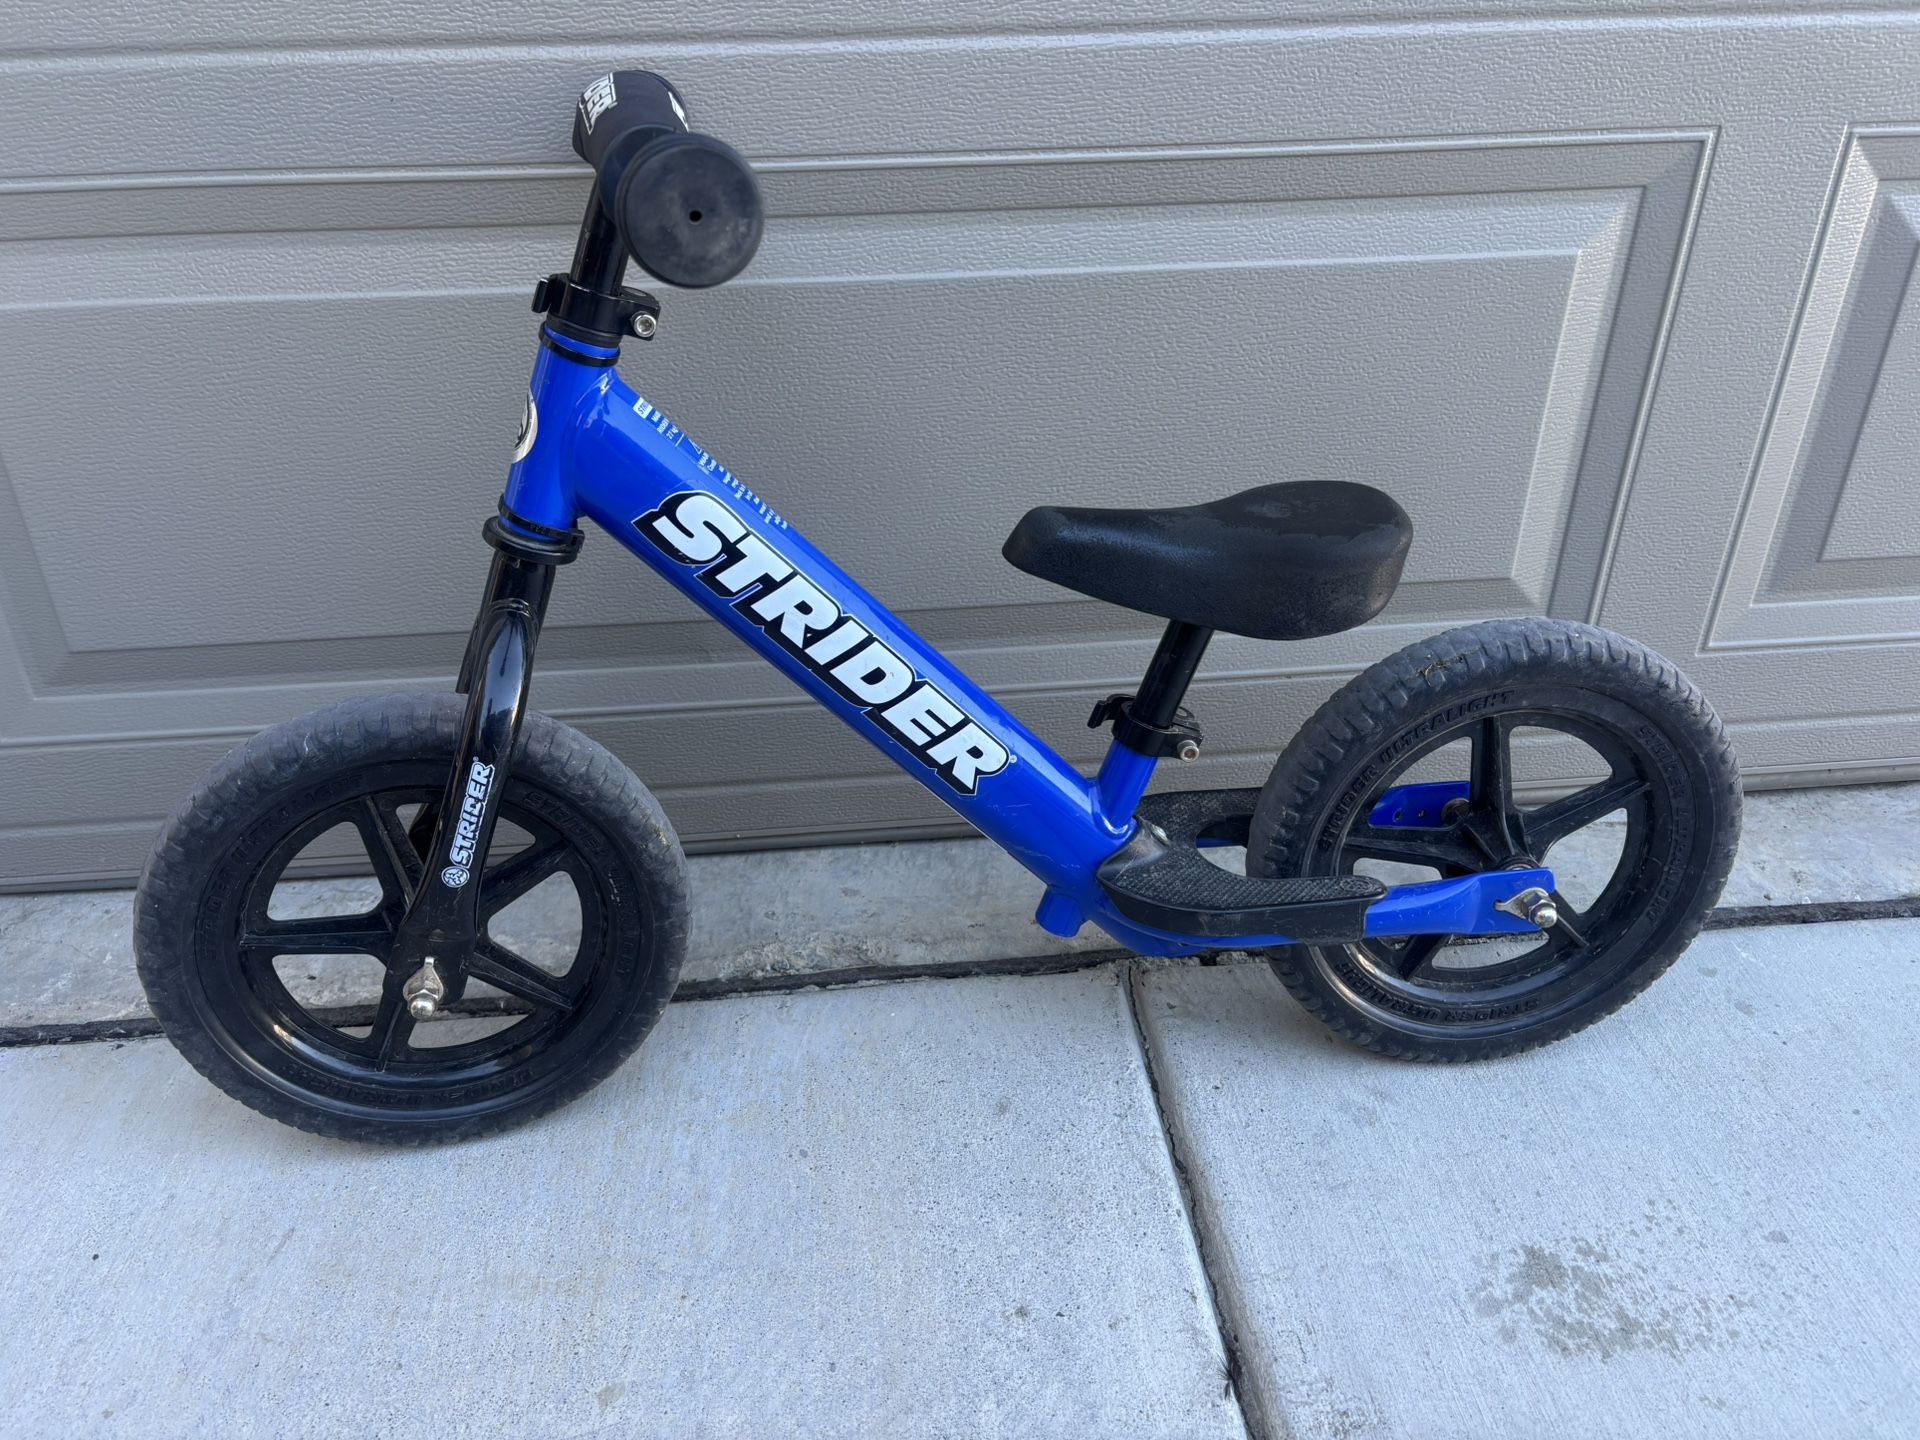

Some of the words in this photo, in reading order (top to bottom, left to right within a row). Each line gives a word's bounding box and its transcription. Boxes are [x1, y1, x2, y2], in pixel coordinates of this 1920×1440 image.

[632, 489, 1014, 796] STRIDER
[450, 761, 496, 869] STRIDER
[1317, 763, 1378, 853] STRIDER
[1379, 690, 1515, 764] ULTRALIGHT
